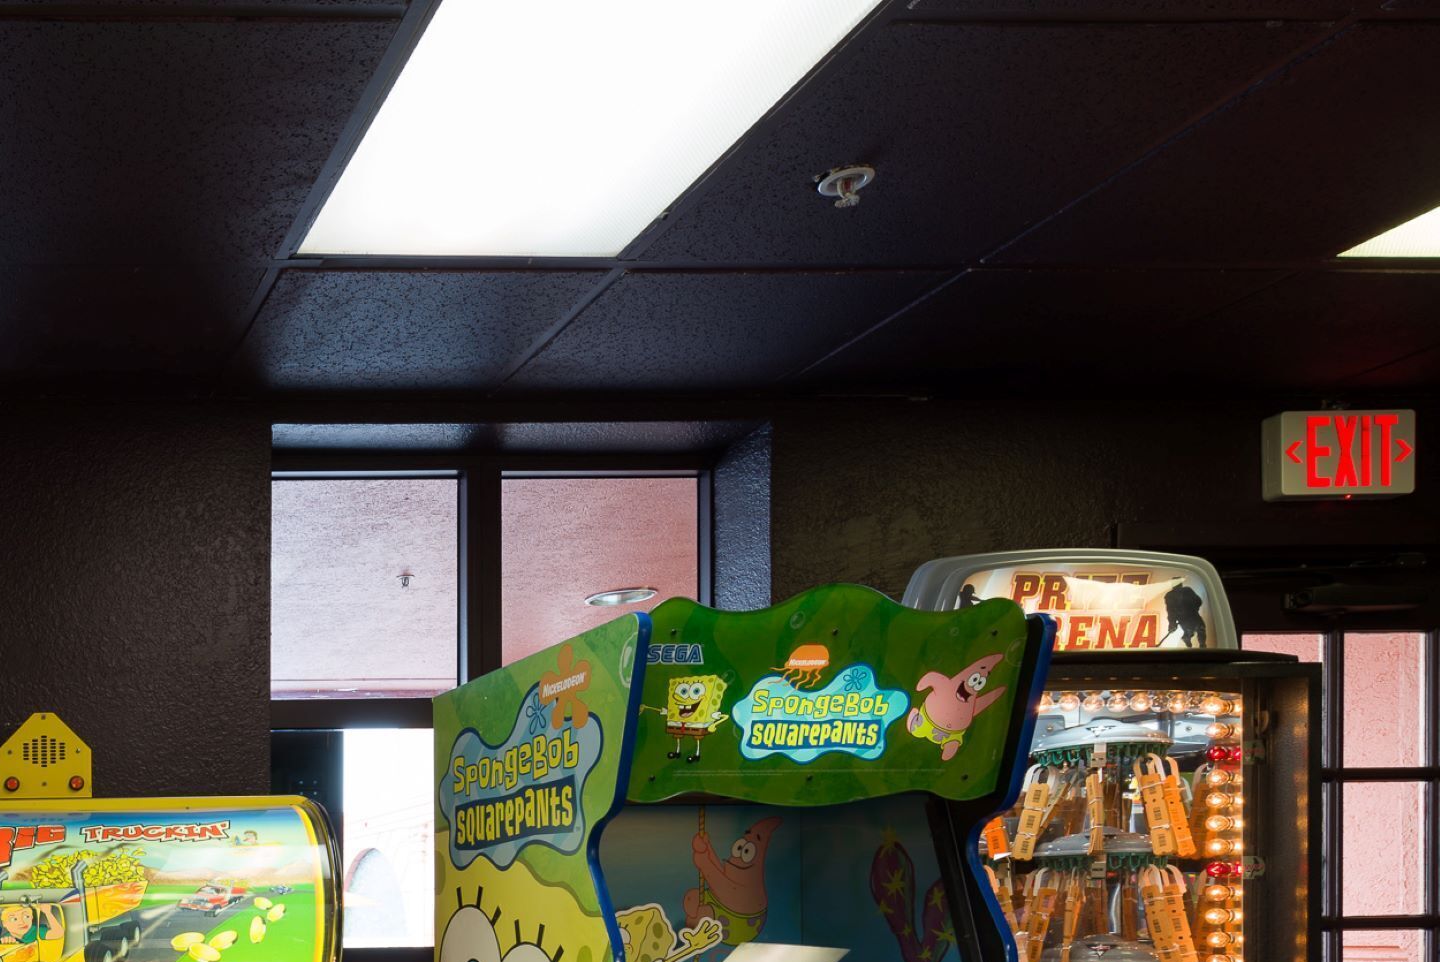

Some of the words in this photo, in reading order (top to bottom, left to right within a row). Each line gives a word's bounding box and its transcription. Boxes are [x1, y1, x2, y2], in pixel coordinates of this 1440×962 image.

[1306, 415, 1399, 488] EXIT
[647, 644, 704, 665] SEGA
[751, 689, 889, 719] SpongeBob
[453, 727, 580, 796] SpongeBob
[79, 820, 231, 843] TRUCKIN'
